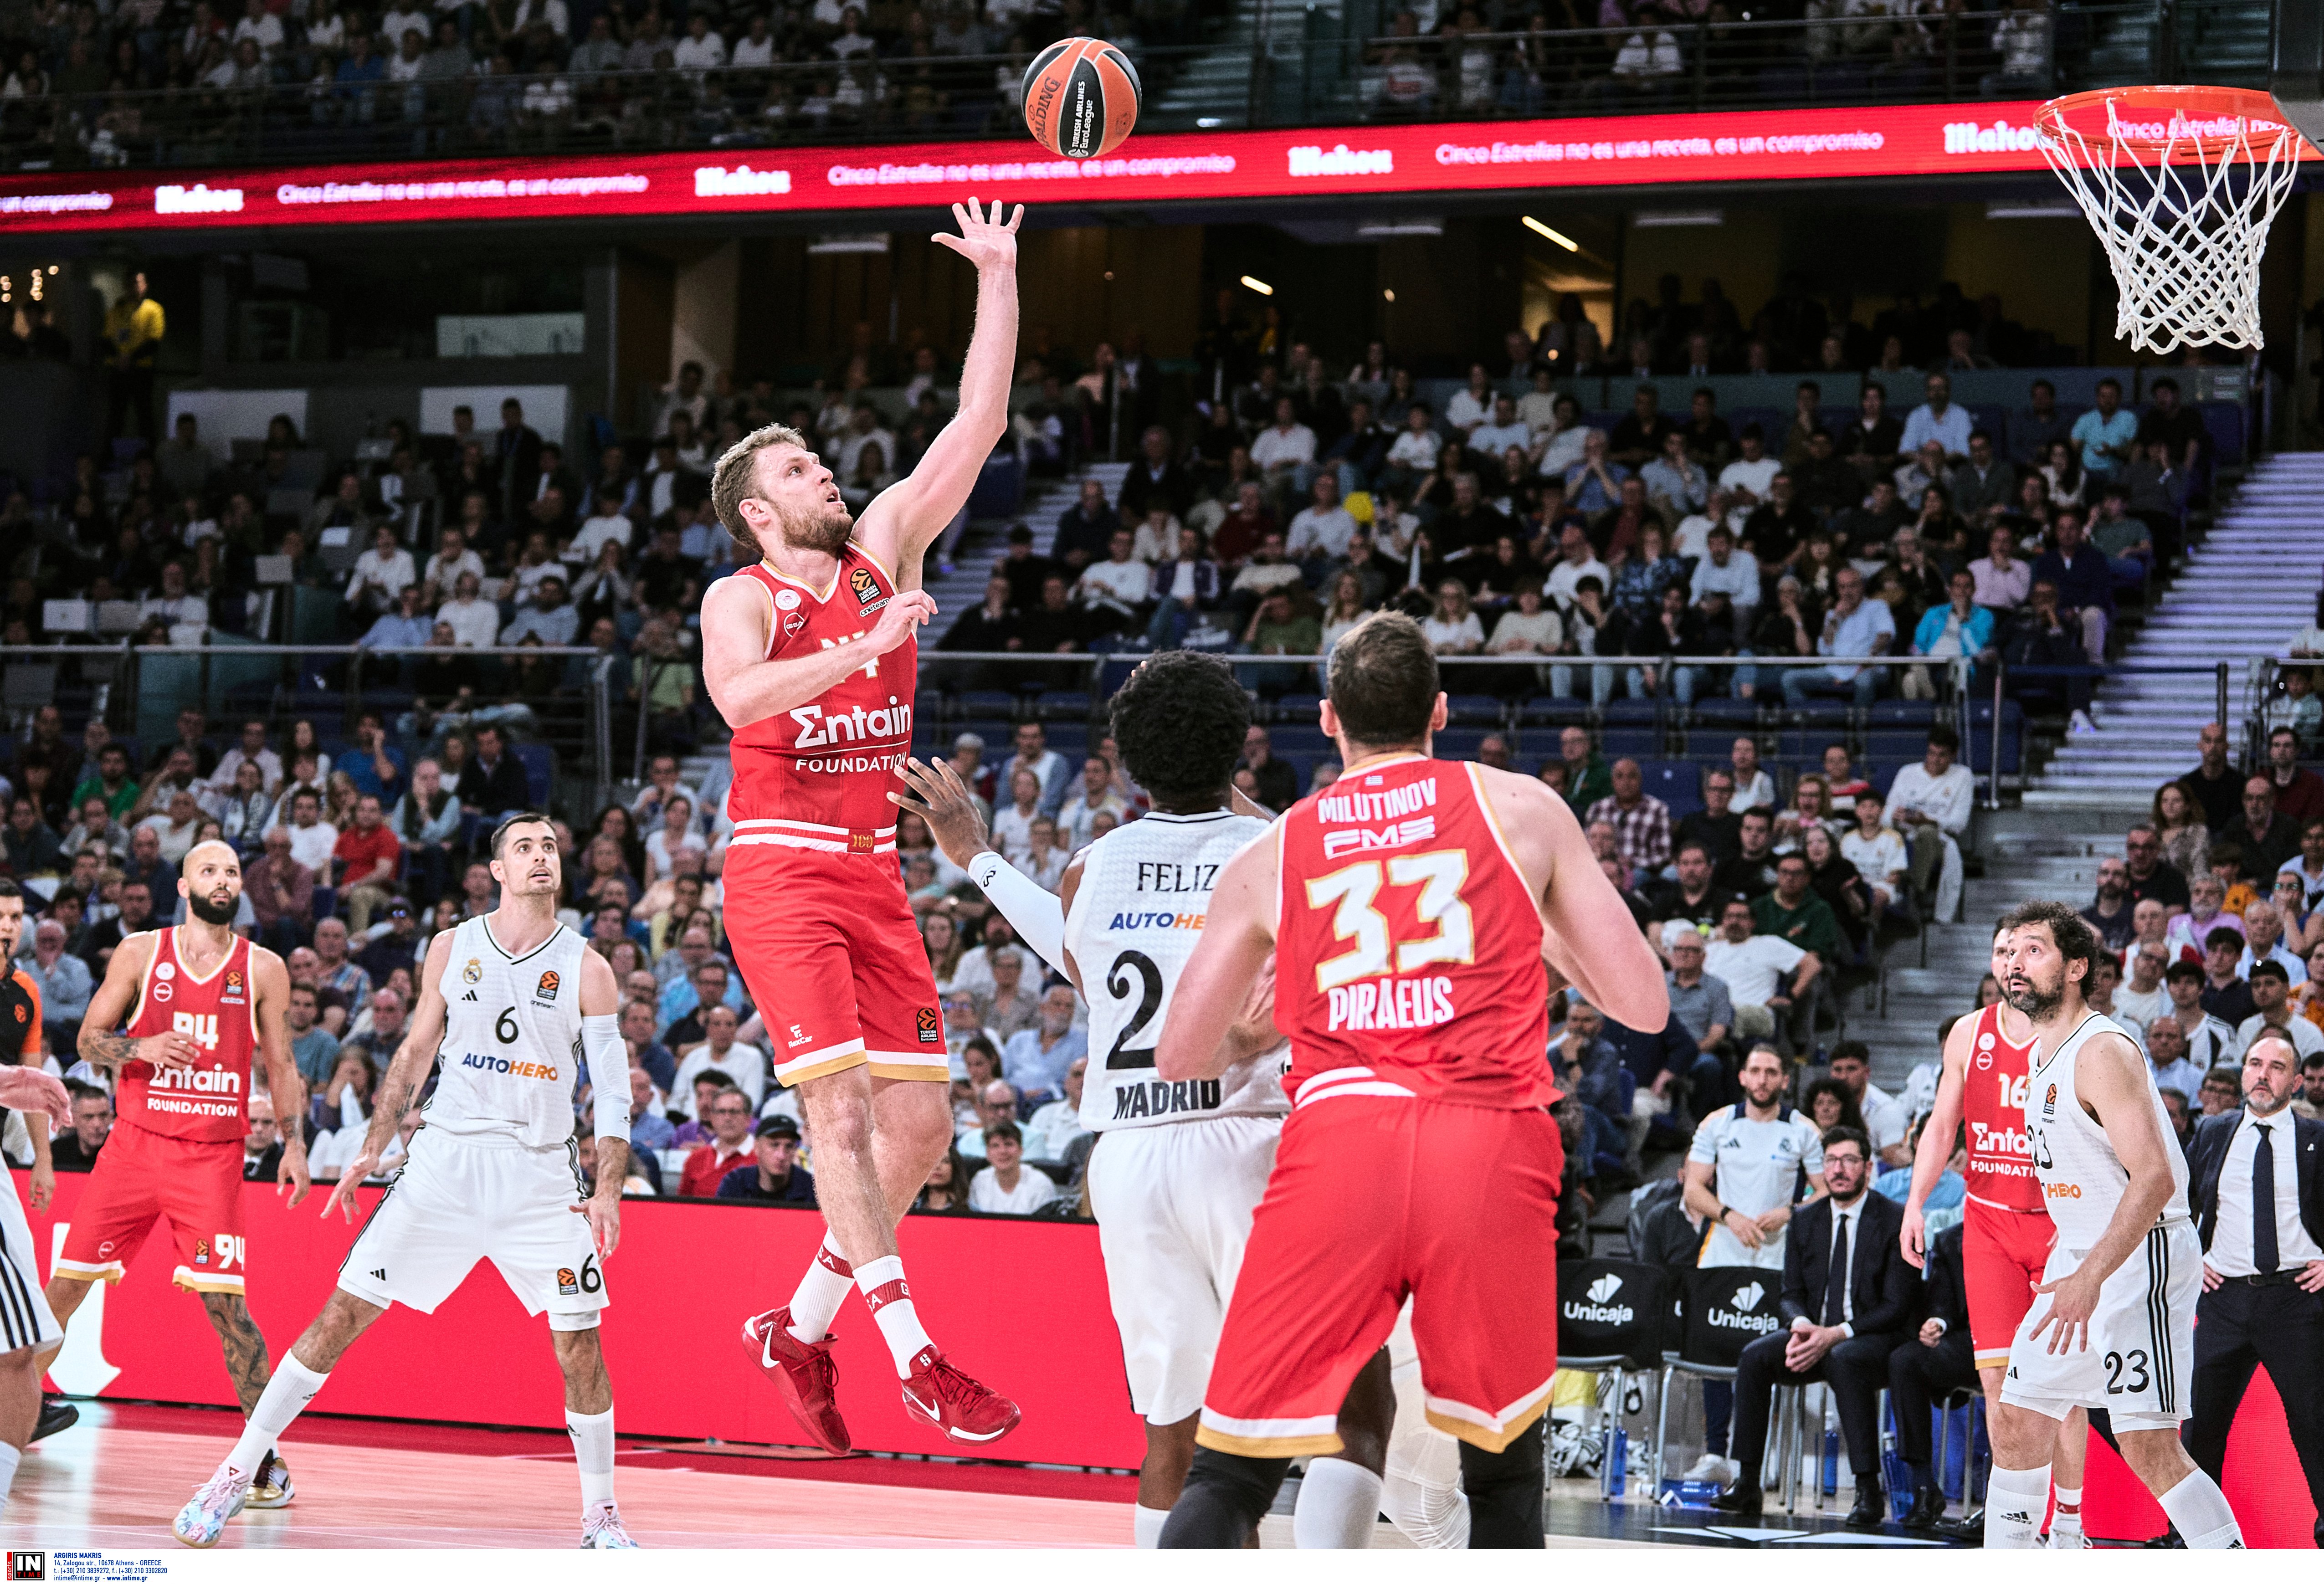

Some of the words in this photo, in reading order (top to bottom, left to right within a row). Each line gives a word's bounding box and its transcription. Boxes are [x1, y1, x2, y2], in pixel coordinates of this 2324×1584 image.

[1035, 76, 1061, 150] PALDING
[1076, 81, 1085, 118] AIRLINES
[1072, 119, 1082, 148] TURKISH
[1080, 99, 1095, 149] EuroLeague
[1435, 144, 1490, 165] Cinco
[1490, 141, 1564, 163] Estrellas
[1565, 143, 1590, 160] no
[1591, 142, 1614, 159] es
[1714, 137, 1738, 155] es
[1739, 137, 1765, 154] un
[1765, 130, 1884, 155] compromiso
[795, 752, 907, 773] FOUNDATION
[1318, 777, 1436, 824] MILUTINOV
[1137, 862, 1220, 892] FELIZ
[1109, 912, 1206, 929] AUTOHE
[1305, 848, 1475, 994] 33
[1106, 950, 1163, 1070] 2
[1328, 976, 1454, 1031] PIRAEUS
[173, 1011, 219, 1050] 94
[496, 1006, 518, 1044] 6
[462, 1052, 558, 1082] AUTOHERO
[147, 1098, 237, 1117] FOUNDATION
[1113, 1078, 1220, 1120] MADRID
[1999, 1073, 2027, 1109] 16
[2027, 1124, 2053, 1169] 23
[1971, 1161, 2035, 1177] FOUNDATI
[2042, 1182, 2082, 1199] HERO
[215, 1234, 245, 1272] 94
[580, 1253, 601, 1294] 6
[1564, 1301, 1633, 1326] Unicaja
[1708, 1307, 1779, 1335] Unicaja
[2104, 1349, 2150, 1395] 23
[2001, 1515, 2032, 1525] adidas
